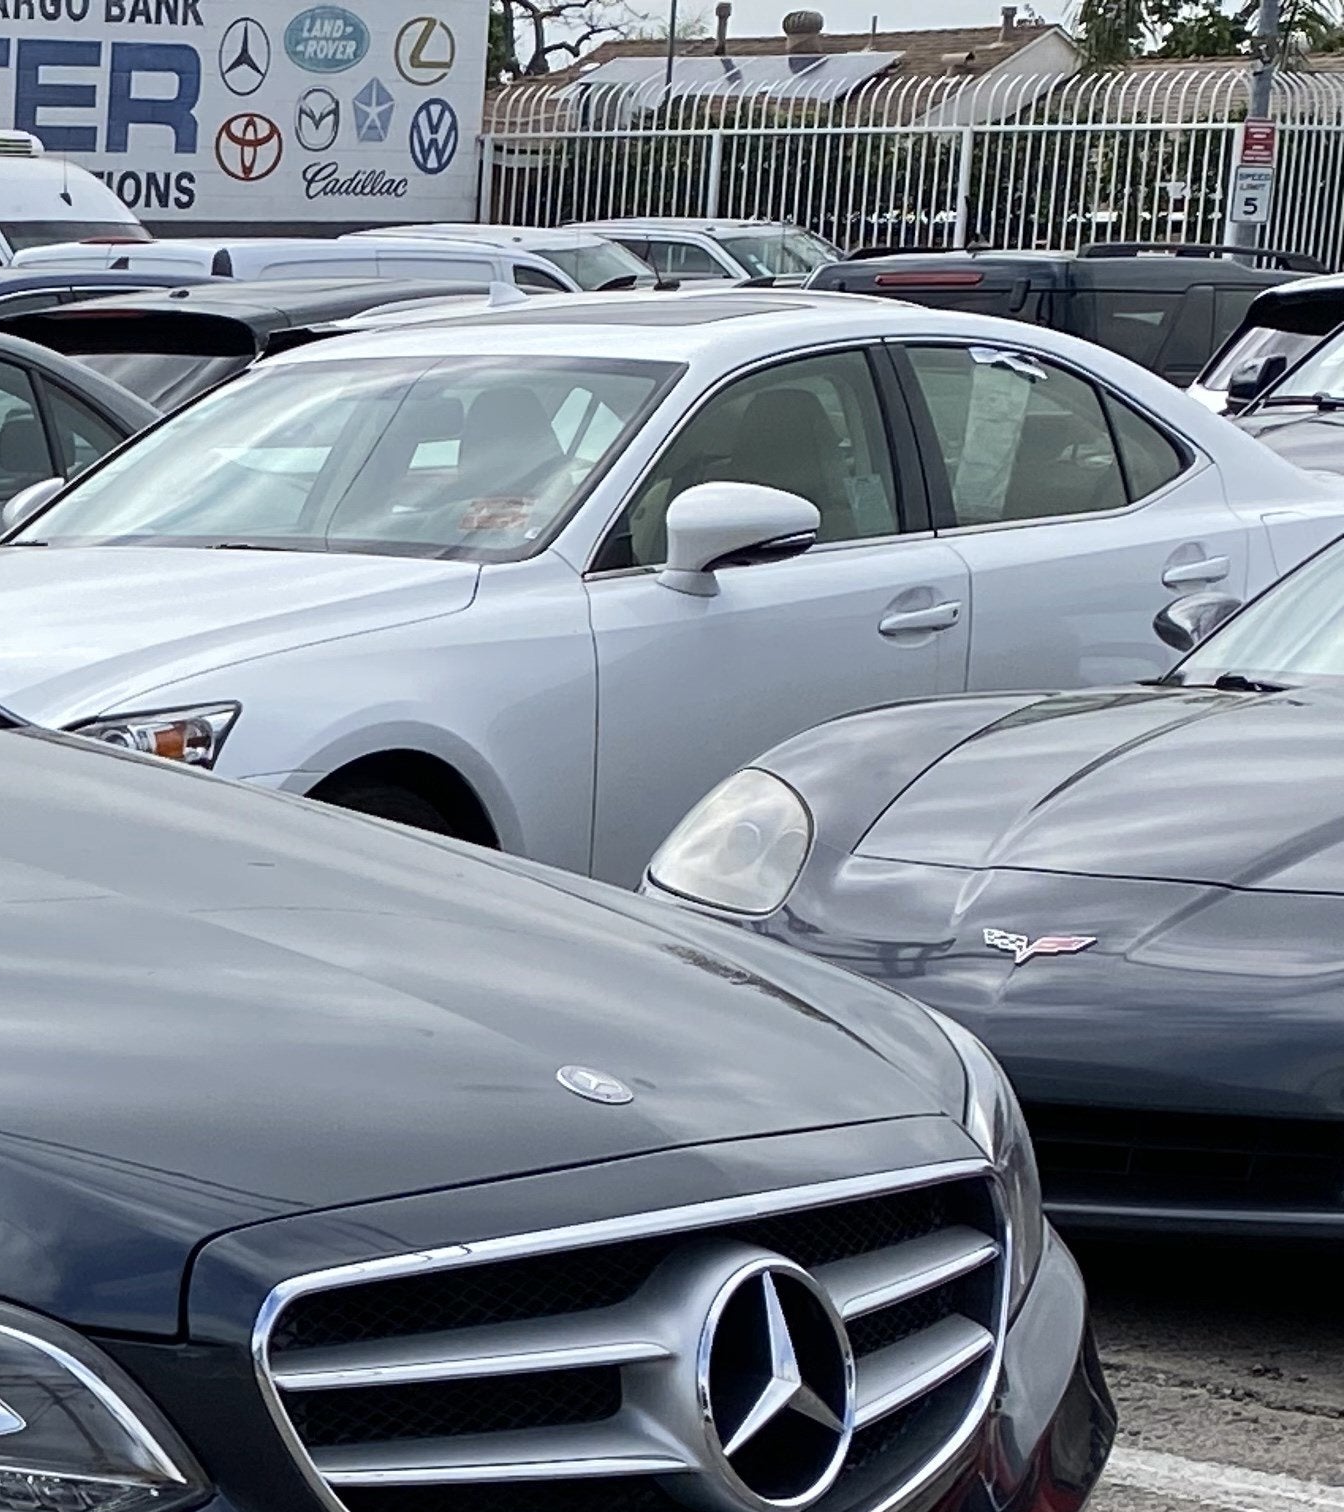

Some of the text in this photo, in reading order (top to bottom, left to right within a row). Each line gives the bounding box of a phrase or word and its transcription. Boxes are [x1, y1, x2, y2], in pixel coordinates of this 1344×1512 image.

[104, 0, 204, 26] BANK
[302, 18, 345, 38] LAND
[304, 39, 358, 60] ROVER
[301, 161, 409, 200] Cadillac
[1242, 197, 1259, 216] 5
